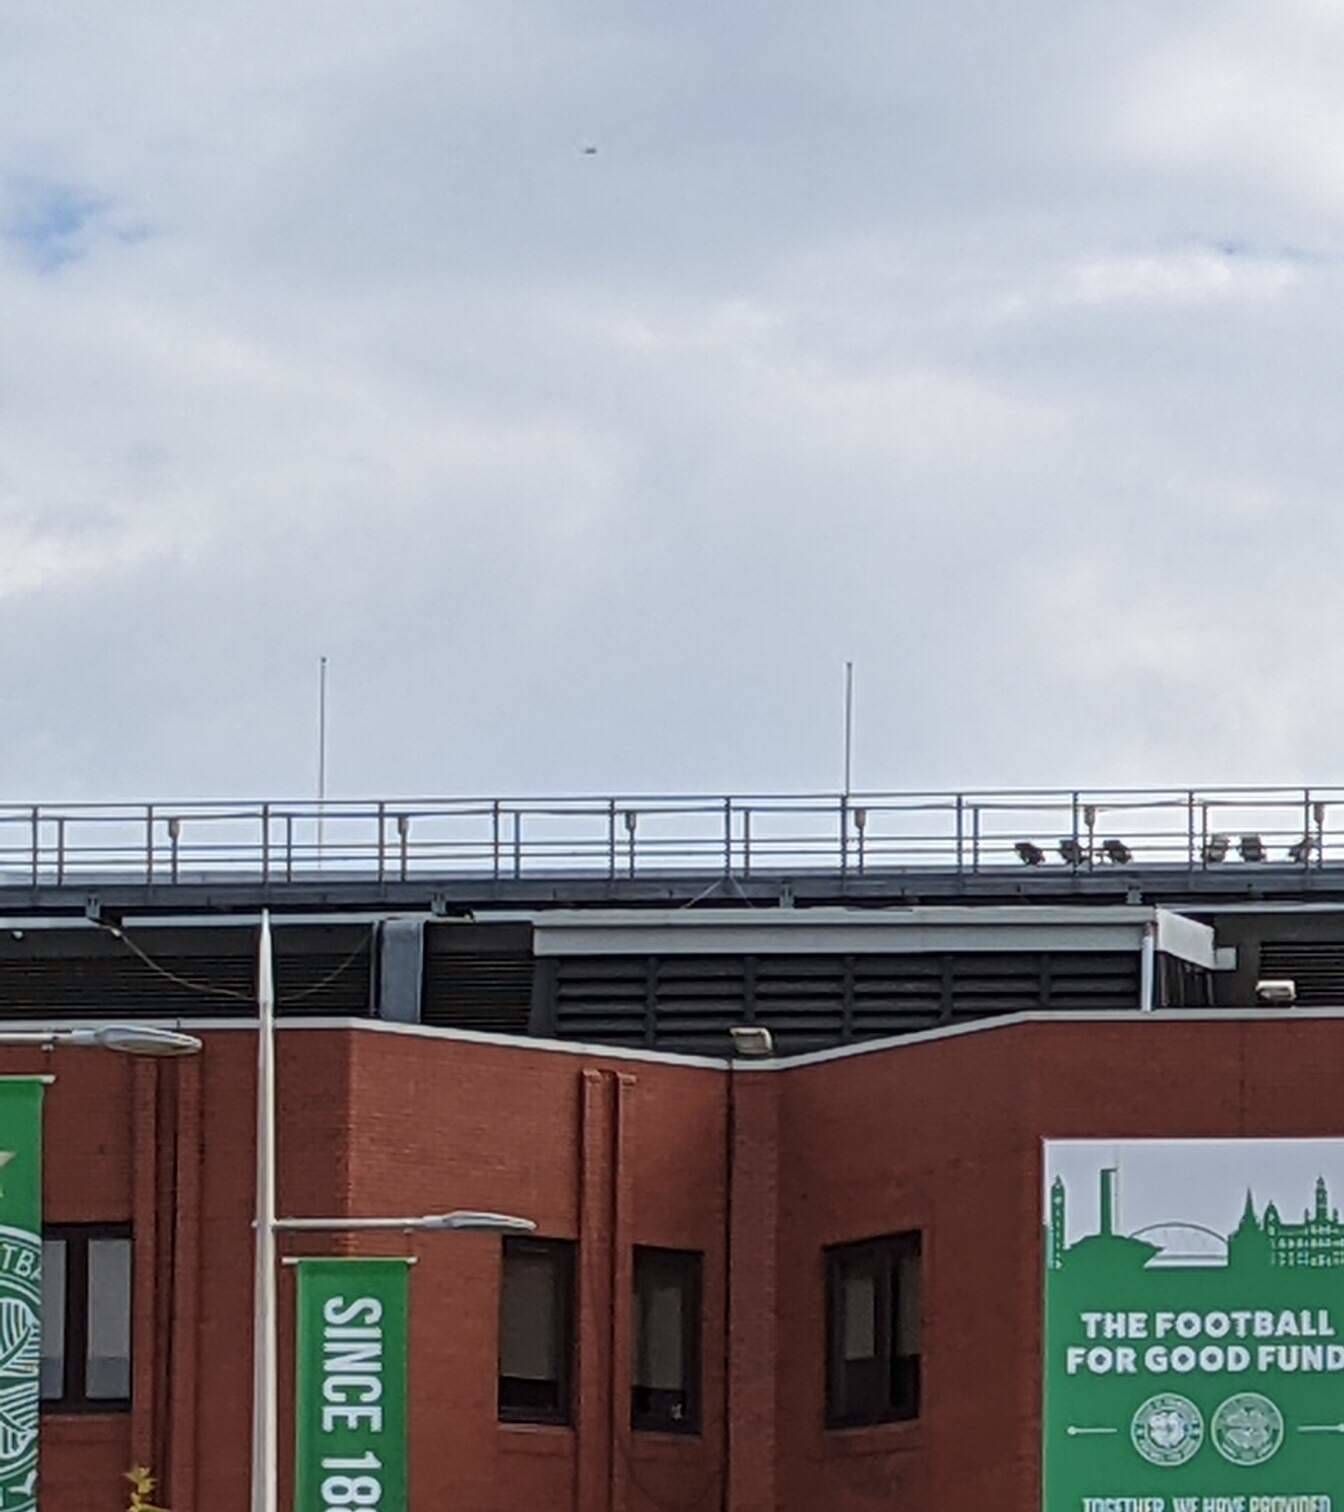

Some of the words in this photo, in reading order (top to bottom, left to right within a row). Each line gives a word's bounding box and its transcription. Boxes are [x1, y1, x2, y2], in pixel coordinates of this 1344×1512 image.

[1080, 1312, 1148, 1339] THE
[1155, 1310, 1335, 1338] FOOTBALL
[322, 1296, 383, 1433] SINCE
[1066, 1347, 1138, 1374] FOR
[1145, 1346, 1250, 1373] GOOD
